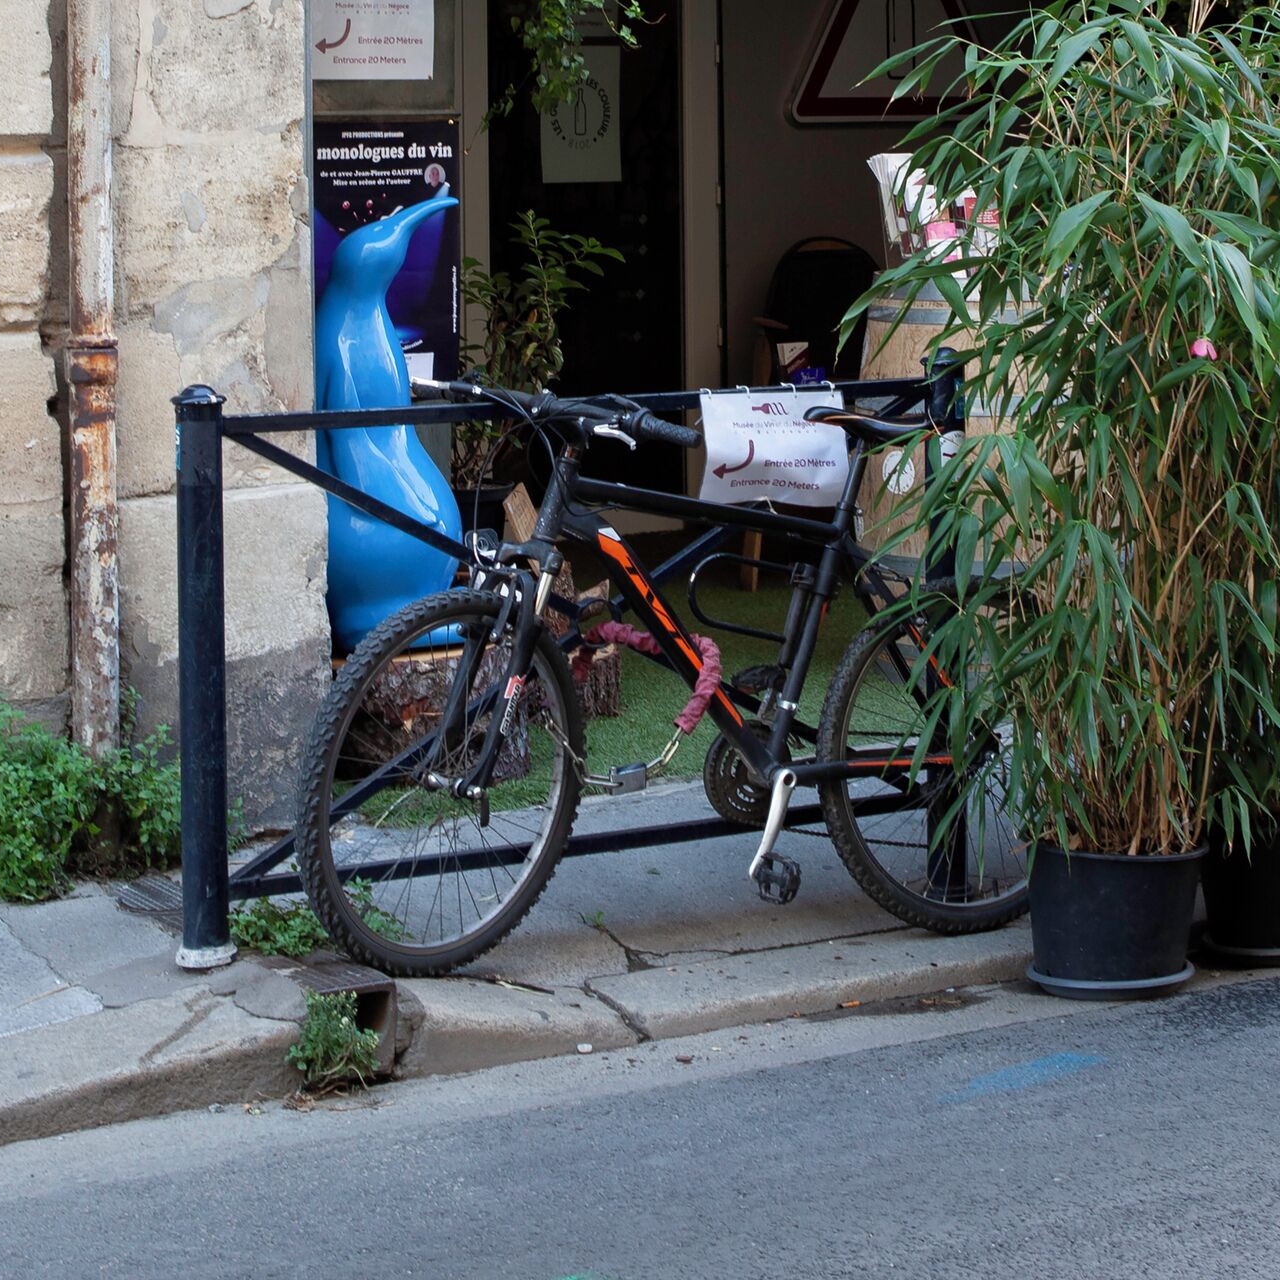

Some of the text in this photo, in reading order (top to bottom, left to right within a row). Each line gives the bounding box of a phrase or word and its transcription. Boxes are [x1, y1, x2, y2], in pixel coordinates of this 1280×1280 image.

[358, 36, 382, 45] Entrée
[383, 36, 395, 45] 20
[333, 56, 407, 64] Entrance 20 Meters
[317, 141, 453, 163] monologues du vin
[320, 170, 329, 178] de
[330, 170, 336, 178] et
[353, 169, 390, 177] Jean-Pierre
[391, 168, 423, 176] GAUFFRE
[377, 178, 385, 186] de
[732, 421, 754, 429] Musée
[764, 458, 836, 468] Entrée 20 Mètres
[730, 479, 820, 490] Entrance 20 Meters
